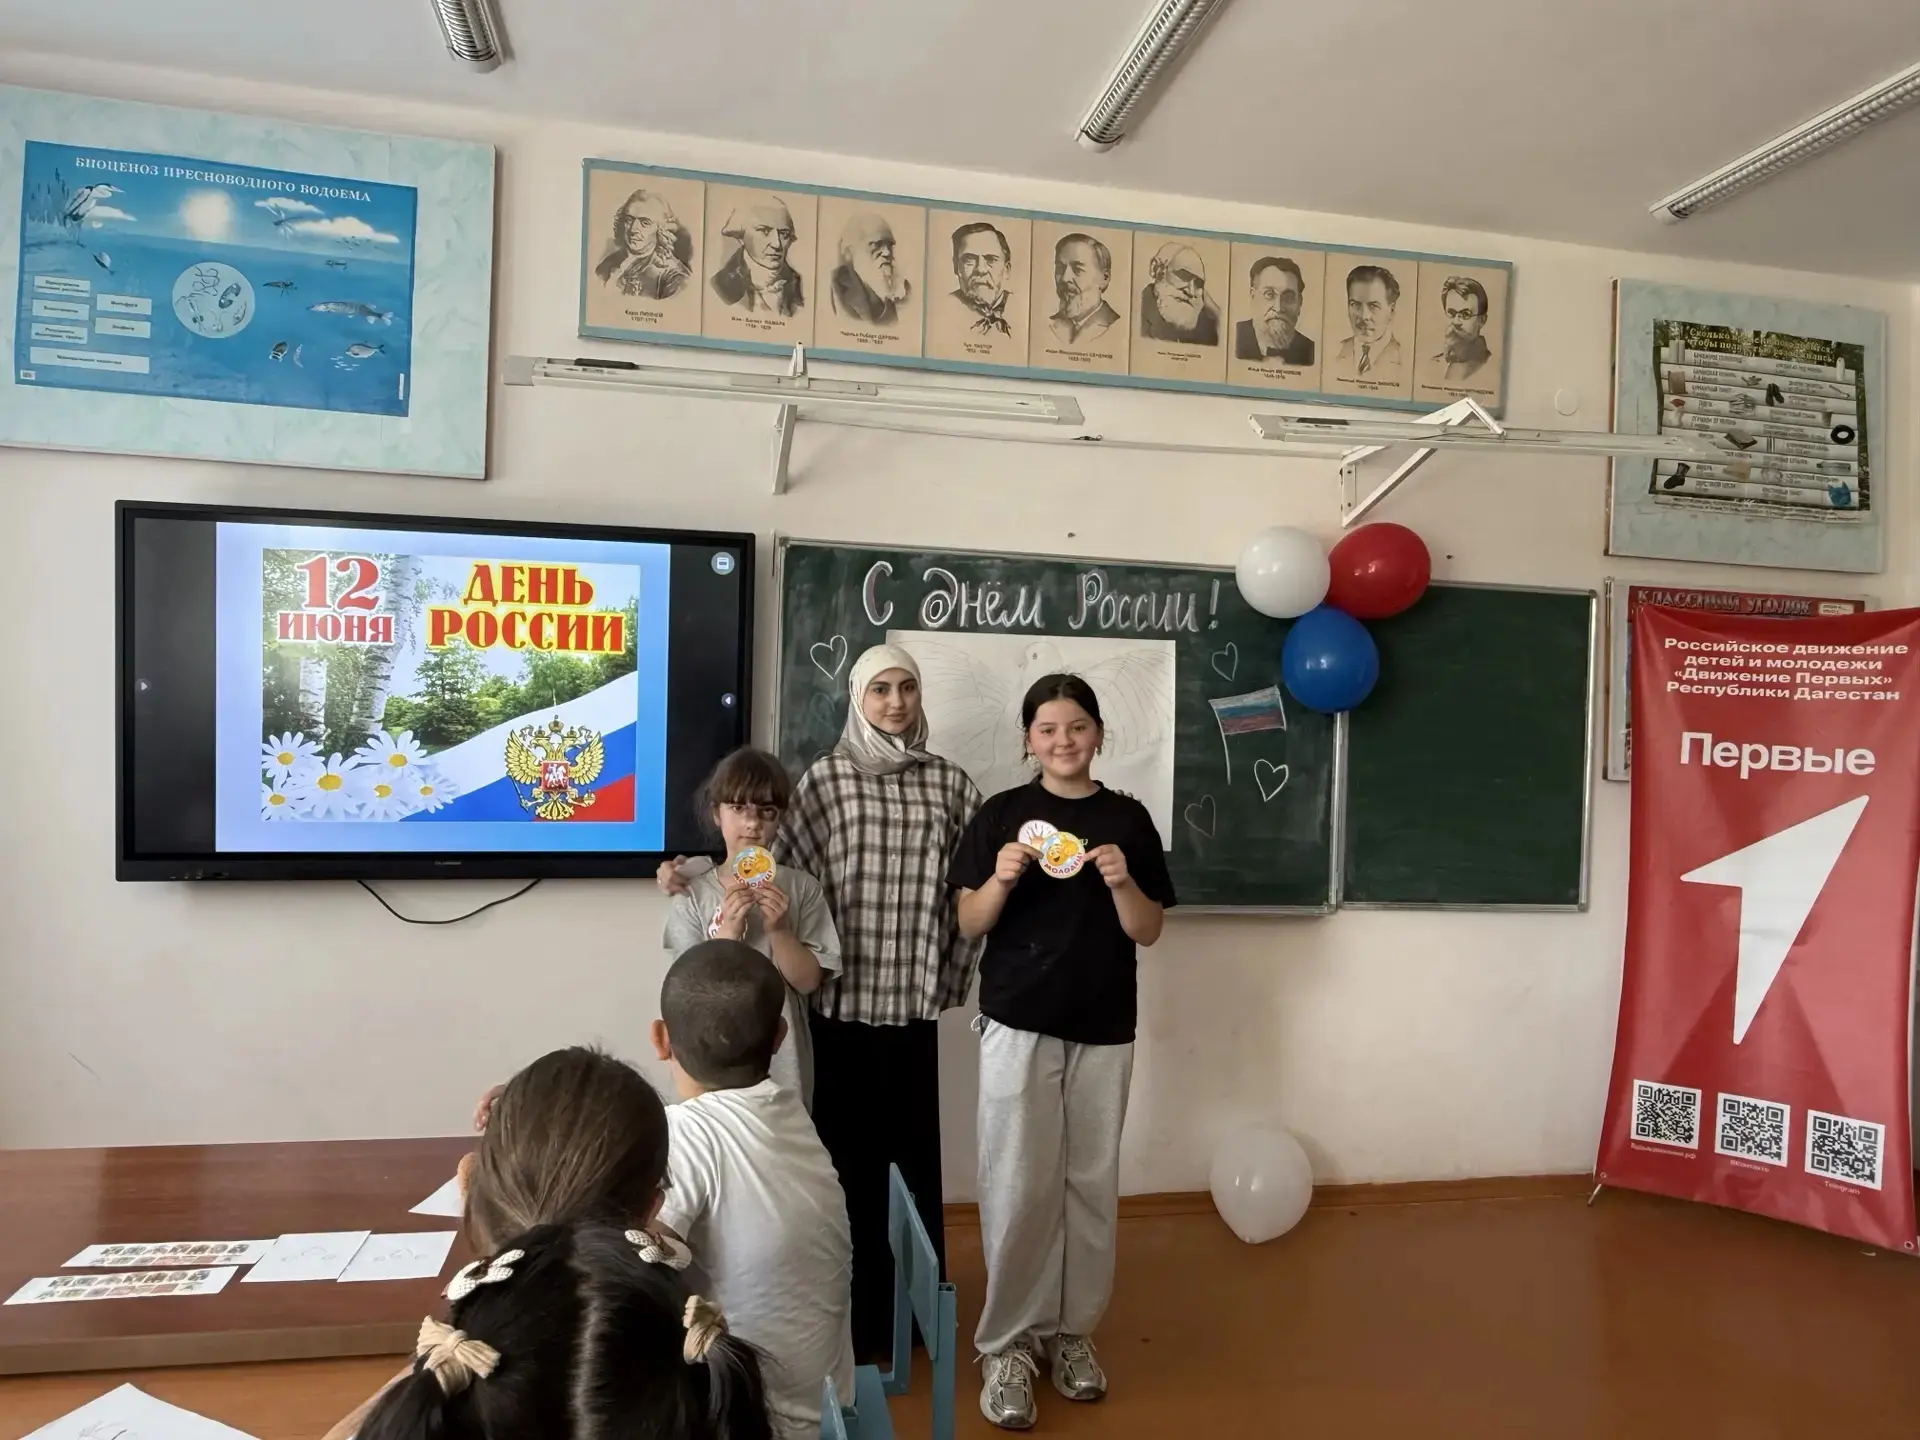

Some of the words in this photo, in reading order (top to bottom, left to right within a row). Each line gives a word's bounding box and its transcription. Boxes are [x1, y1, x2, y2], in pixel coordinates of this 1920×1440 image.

[76, 157, 159, 176] БИОЦЕНОЗ
[164, 166, 295, 194] ПРЕСНОВОДНОГО
[300, 184, 372, 202] ВОДОЕМА
[1689, 327, 1731, 340] Сколько
[296, 556, 380, 611] 12
[463, 562, 594, 608] ДЕНЬ
[1637, 589, 1740, 612] КЛАССНЫЙ
[277, 611, 395, 643] ИЮНЯ
[428, 608, 626, 653] РОССИИ
[1664, 637, 1789, 653] Российское
[1793, 643, 1909, 656] движение
[1684, 654, 1745, 668] детей
[1748, 658, 1762, 668] и
[1766, 659, 1883, 671] молодежи
[1674, 667, 1791, 683] «Движение
[1795, 672, 1893, 686] Первых»
[1666, 680, 1790, 698] Республики
[1794, 687, 1901, 701] Дагестан
[1680, 731, 1876, 779] Первые
[1824, 1180, 1861, 1195] Telegram
